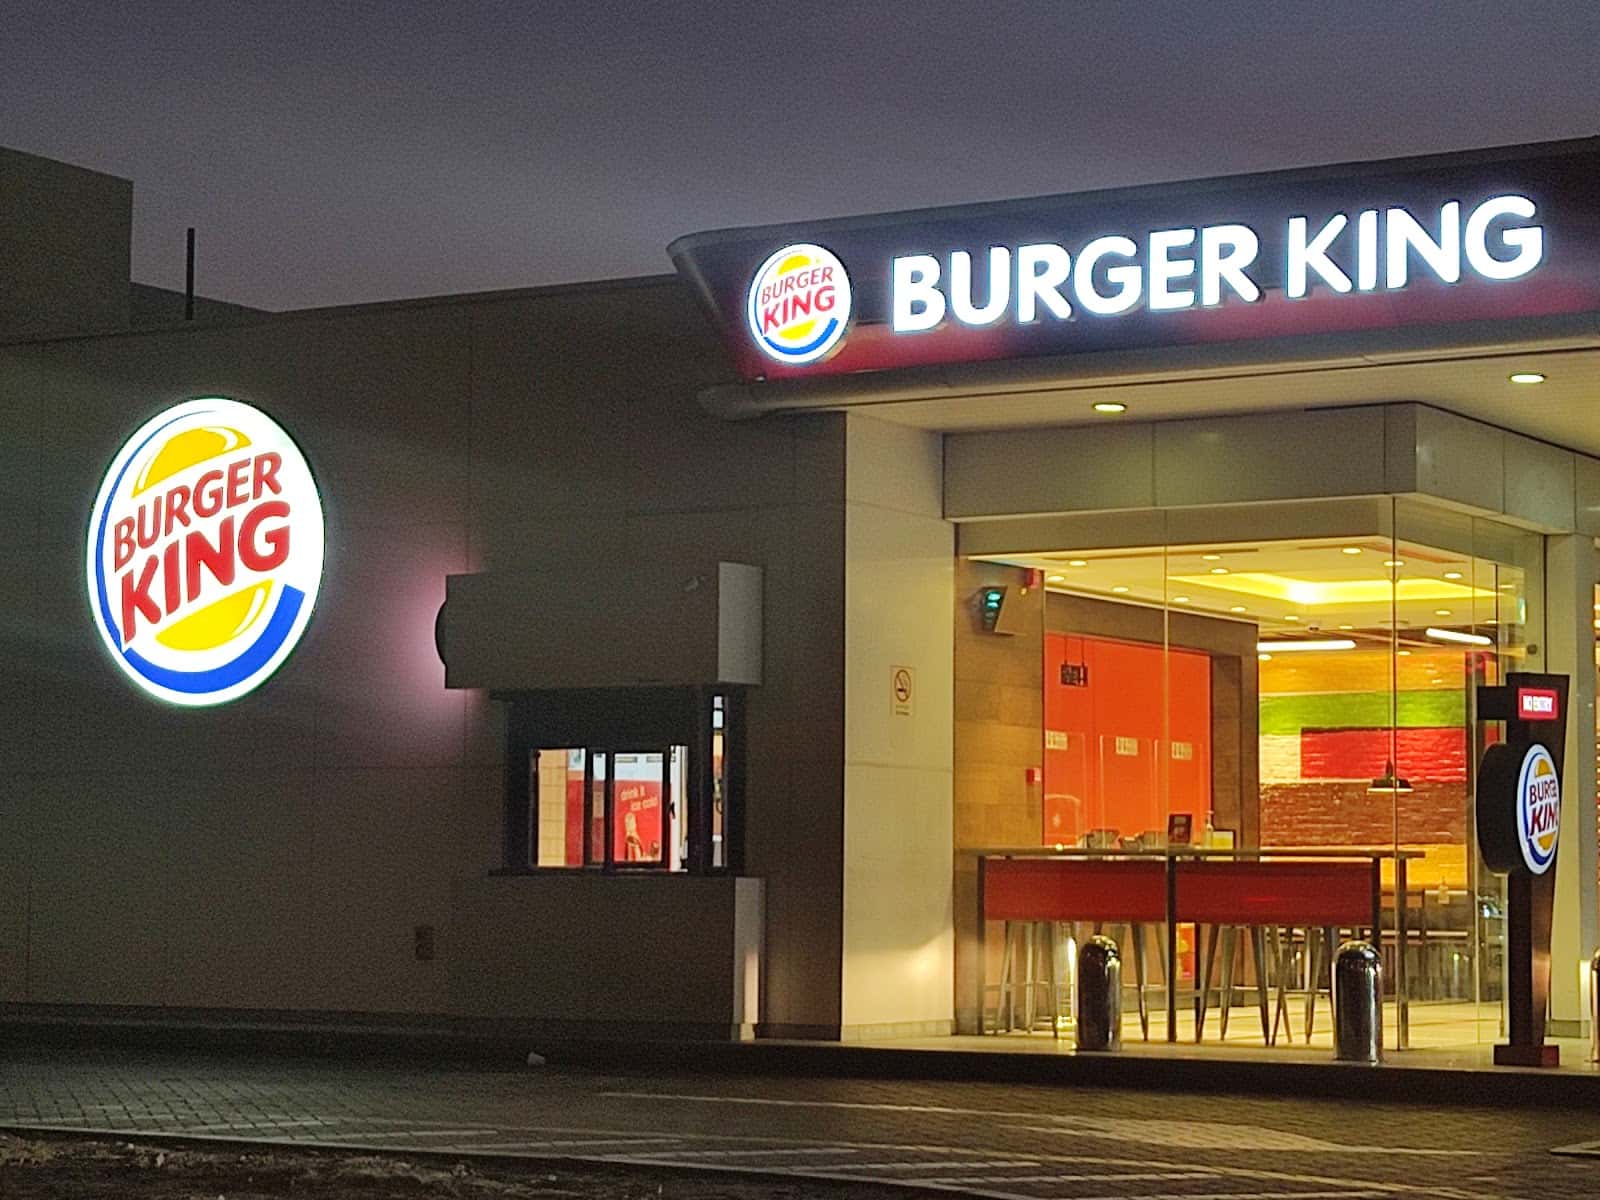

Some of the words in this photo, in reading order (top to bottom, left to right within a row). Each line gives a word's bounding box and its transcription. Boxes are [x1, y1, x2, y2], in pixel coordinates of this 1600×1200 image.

[761, 266, 834, 305] BURGER
[892, 224, 1261, 332] BURGER
[1287, 195, 1544, 298] KING
[763, 285, 835, 335] KING
[114, 451, 283, 573] BURGER
[121, 500, 291, 643] KING
[1530, 802, 1559, 836] KIN
